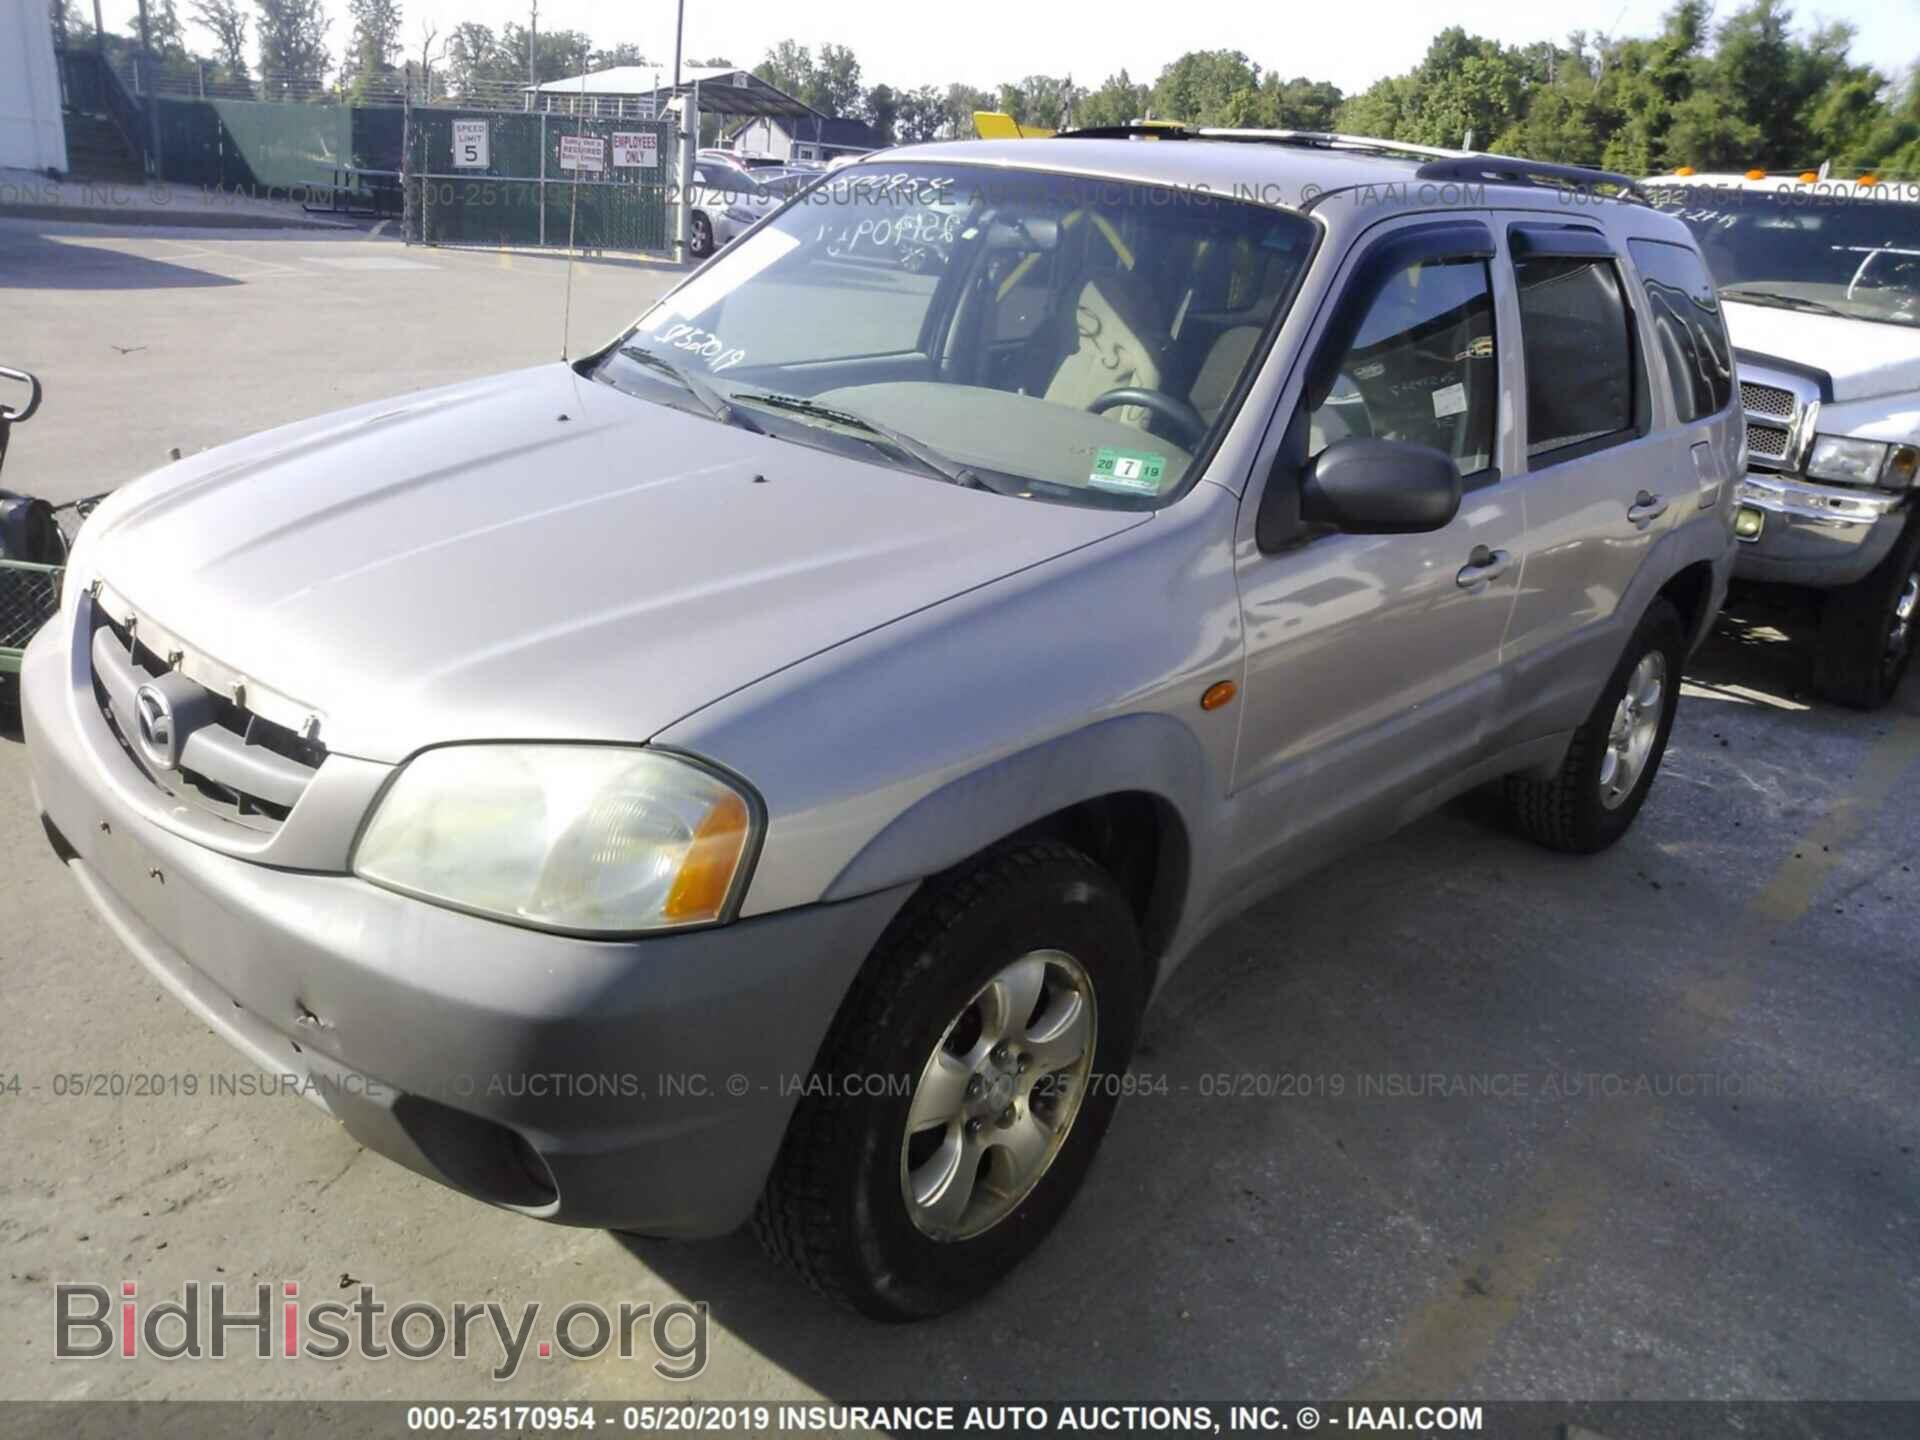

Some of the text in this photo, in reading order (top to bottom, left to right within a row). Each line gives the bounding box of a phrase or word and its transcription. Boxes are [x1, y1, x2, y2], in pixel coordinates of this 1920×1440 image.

[457, 124, 483, 133] SPEED
[459, 134, 482, 143] LIMIT
[615, 135, 657, 149] EMPLOYEES
[465, 145, 478, 161] 5
[625, 151, 645, 163] ONLY
[1125, 460, 1134, 475] 7
[1144, 465, 1159, 477] 19
